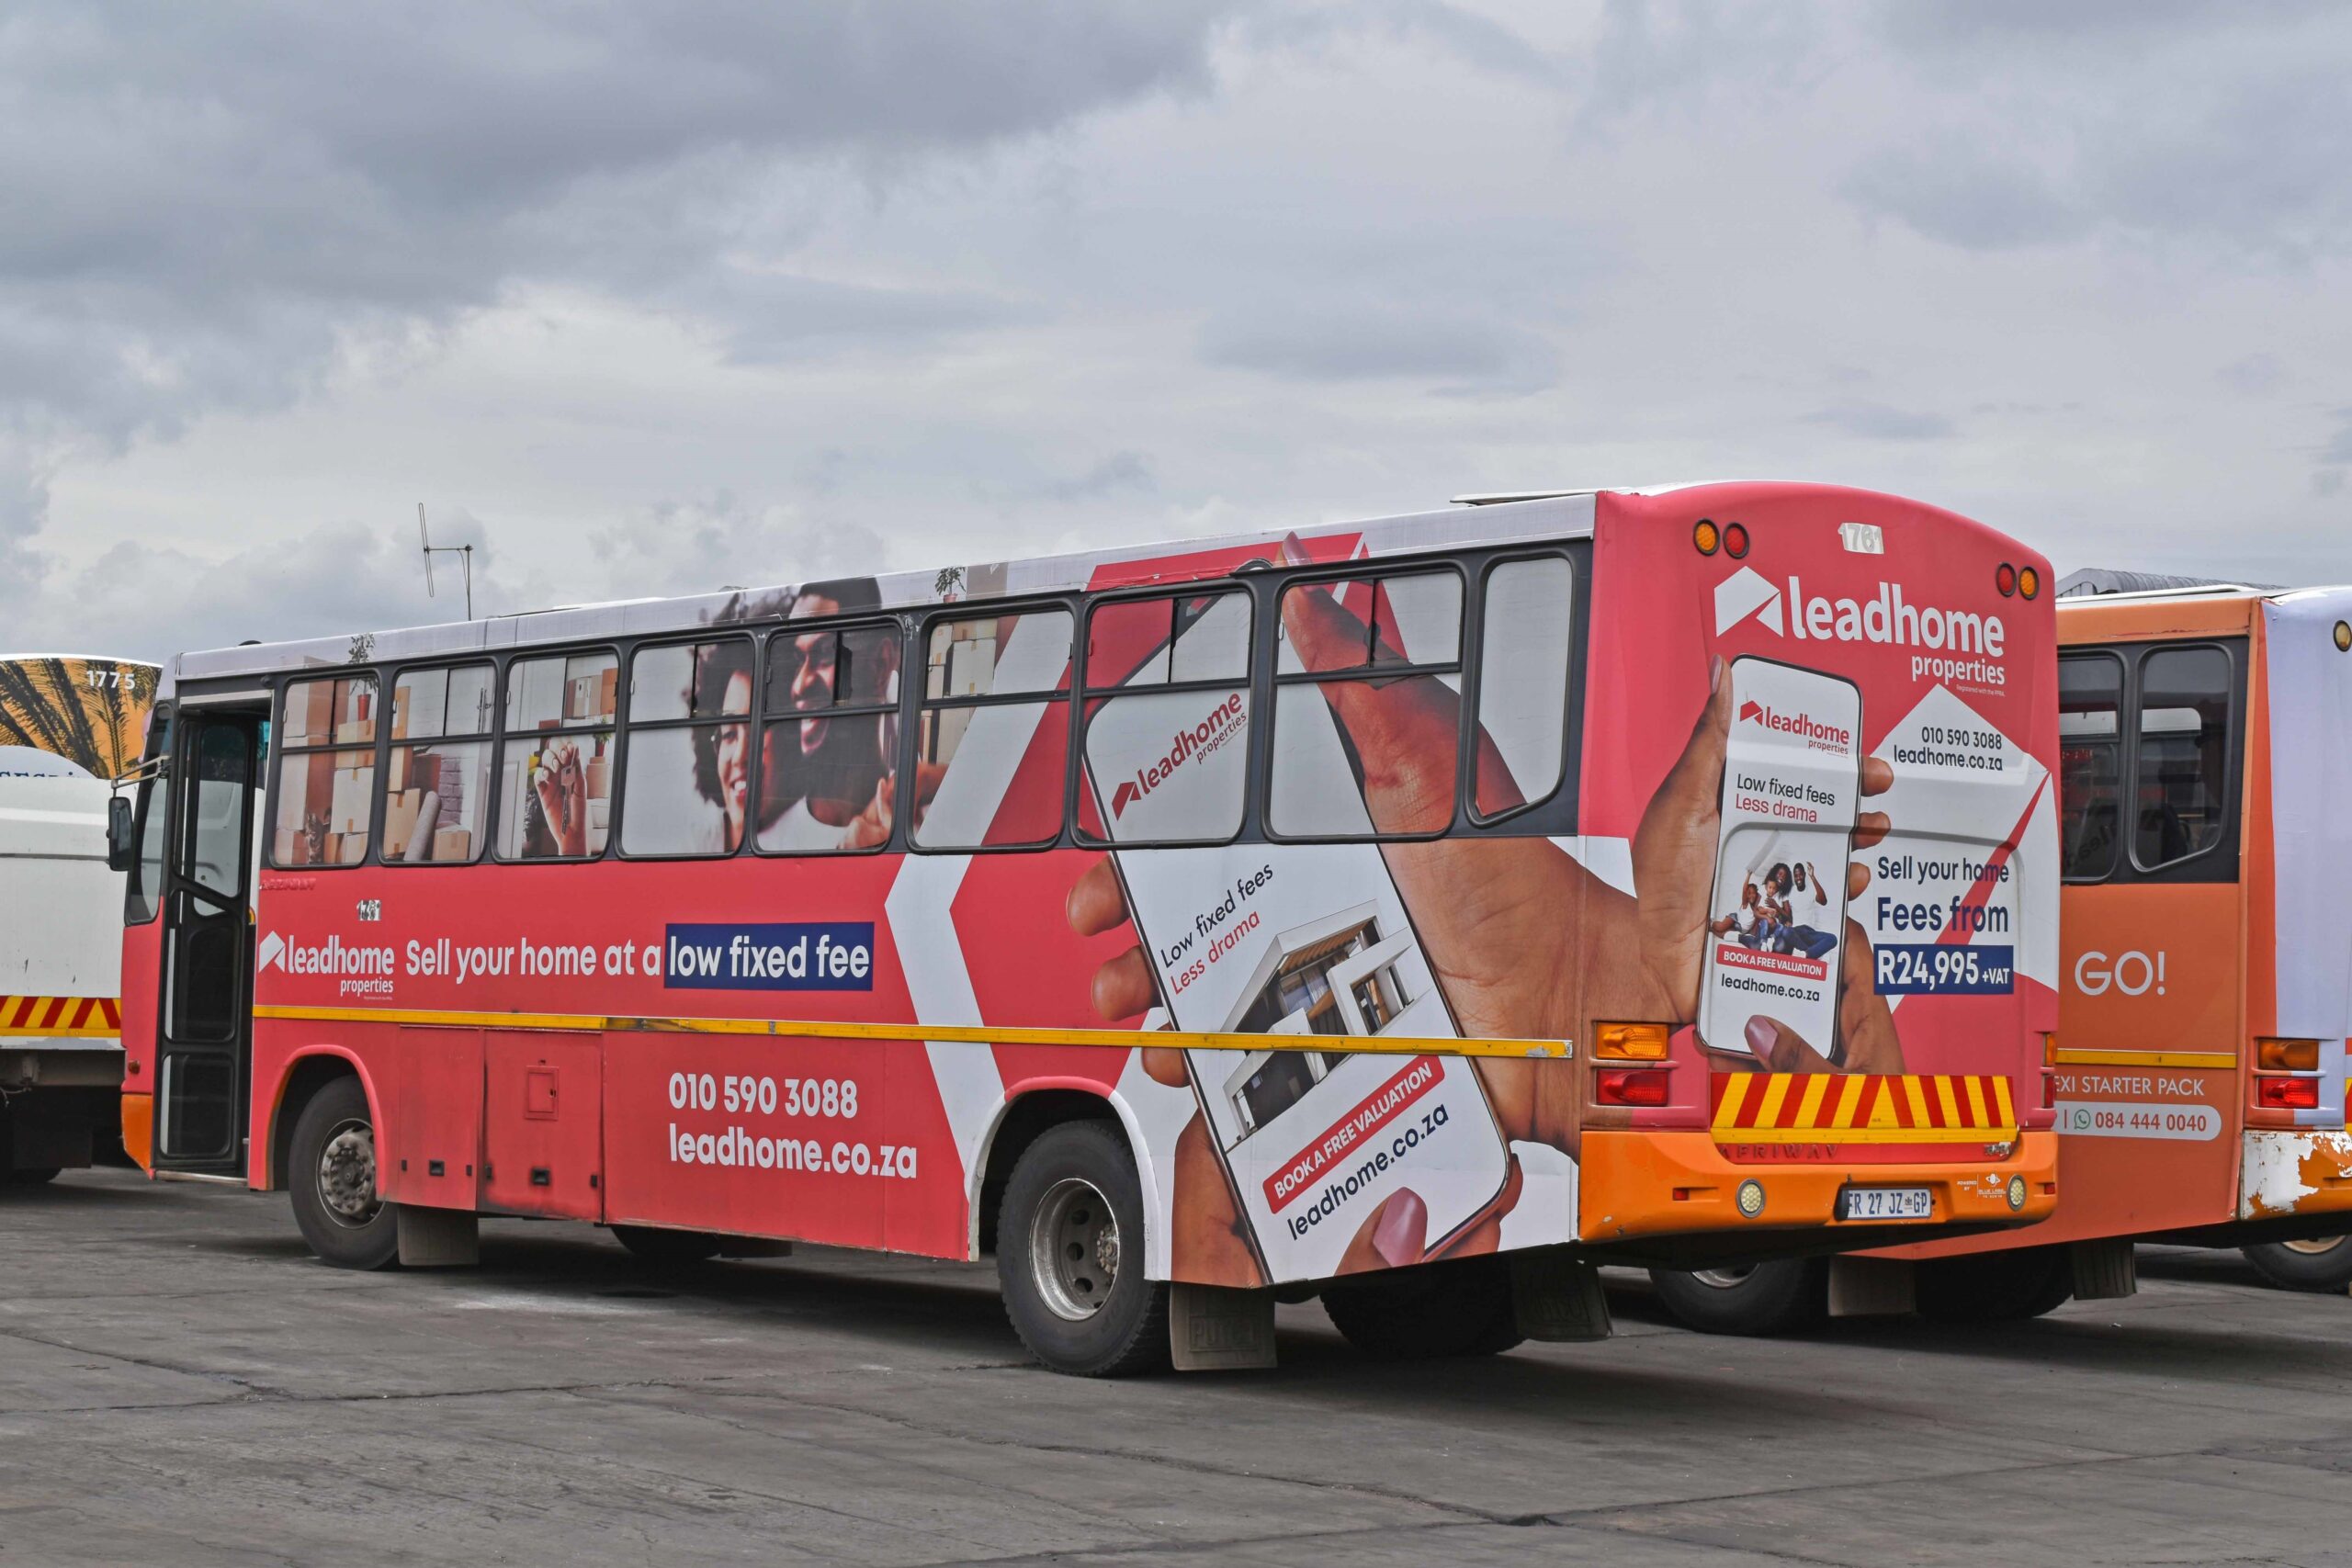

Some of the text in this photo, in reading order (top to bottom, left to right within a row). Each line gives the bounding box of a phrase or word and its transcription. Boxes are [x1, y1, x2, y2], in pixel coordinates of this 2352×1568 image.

[1788, 576, 2005, 658] leadhome
[86, 671, 136, 690] 1775
[1912, 655, 2005, 685] properties
[1196, 711, 1247, 765] properties
[1765, 705, 1849, 745] leadhome
[1921, 726, 2002, 750] 010 590 3088
[1136, 693, 1242, 795] leadhome
[1808, 739, 1849, 755] properties
[1894, 744, 2003, 772] leadhome.co.za
[1736, 773, 1836, 807] Low fixed fees
[1736, 793, 1817, 824] Less drama
[1877, 855, 2009, 886] Sell your home
[1160, 863, 1273, 968] Low fixed fees
[1877, 896, 2008, 932] Fees from
[288, 934, 395, 975] leadhome
[405, 934, 870, 985] Sell your home at a low fixed fee
[1170, 910, 1261, 996] Less drama
[1724, 951, 1822, 976] BOOK A FREE VALUATION
[1877, 949, 2010, 991] R24,995 +VAT
[340, 976, 394, 998] properties
[1721, 973, 1820, 1002] leadhome.co.za
[2075, 951, 2165, 997] GO!
[669, 1072, 858, 1119] 010 590 3088
[2081, 1076, 2152, 1095] STARTER
[2158, 1078, 2205, 1096] PACK
[1273, 1062, 1433, 1200] BOOK A FREE VALUATION
[2095, 1112, 2207, 1132] 084 444 0040
[669, 1122, 917, 1179] leadhome.co.za
[1287, 1103, 1449, 1241] leadhome.co.za
[1868, 1192, 1883, 1214] 27
[1889, 1192, 1903, 1214] JZ
[1913, 1191, 1928, 1213] GP
